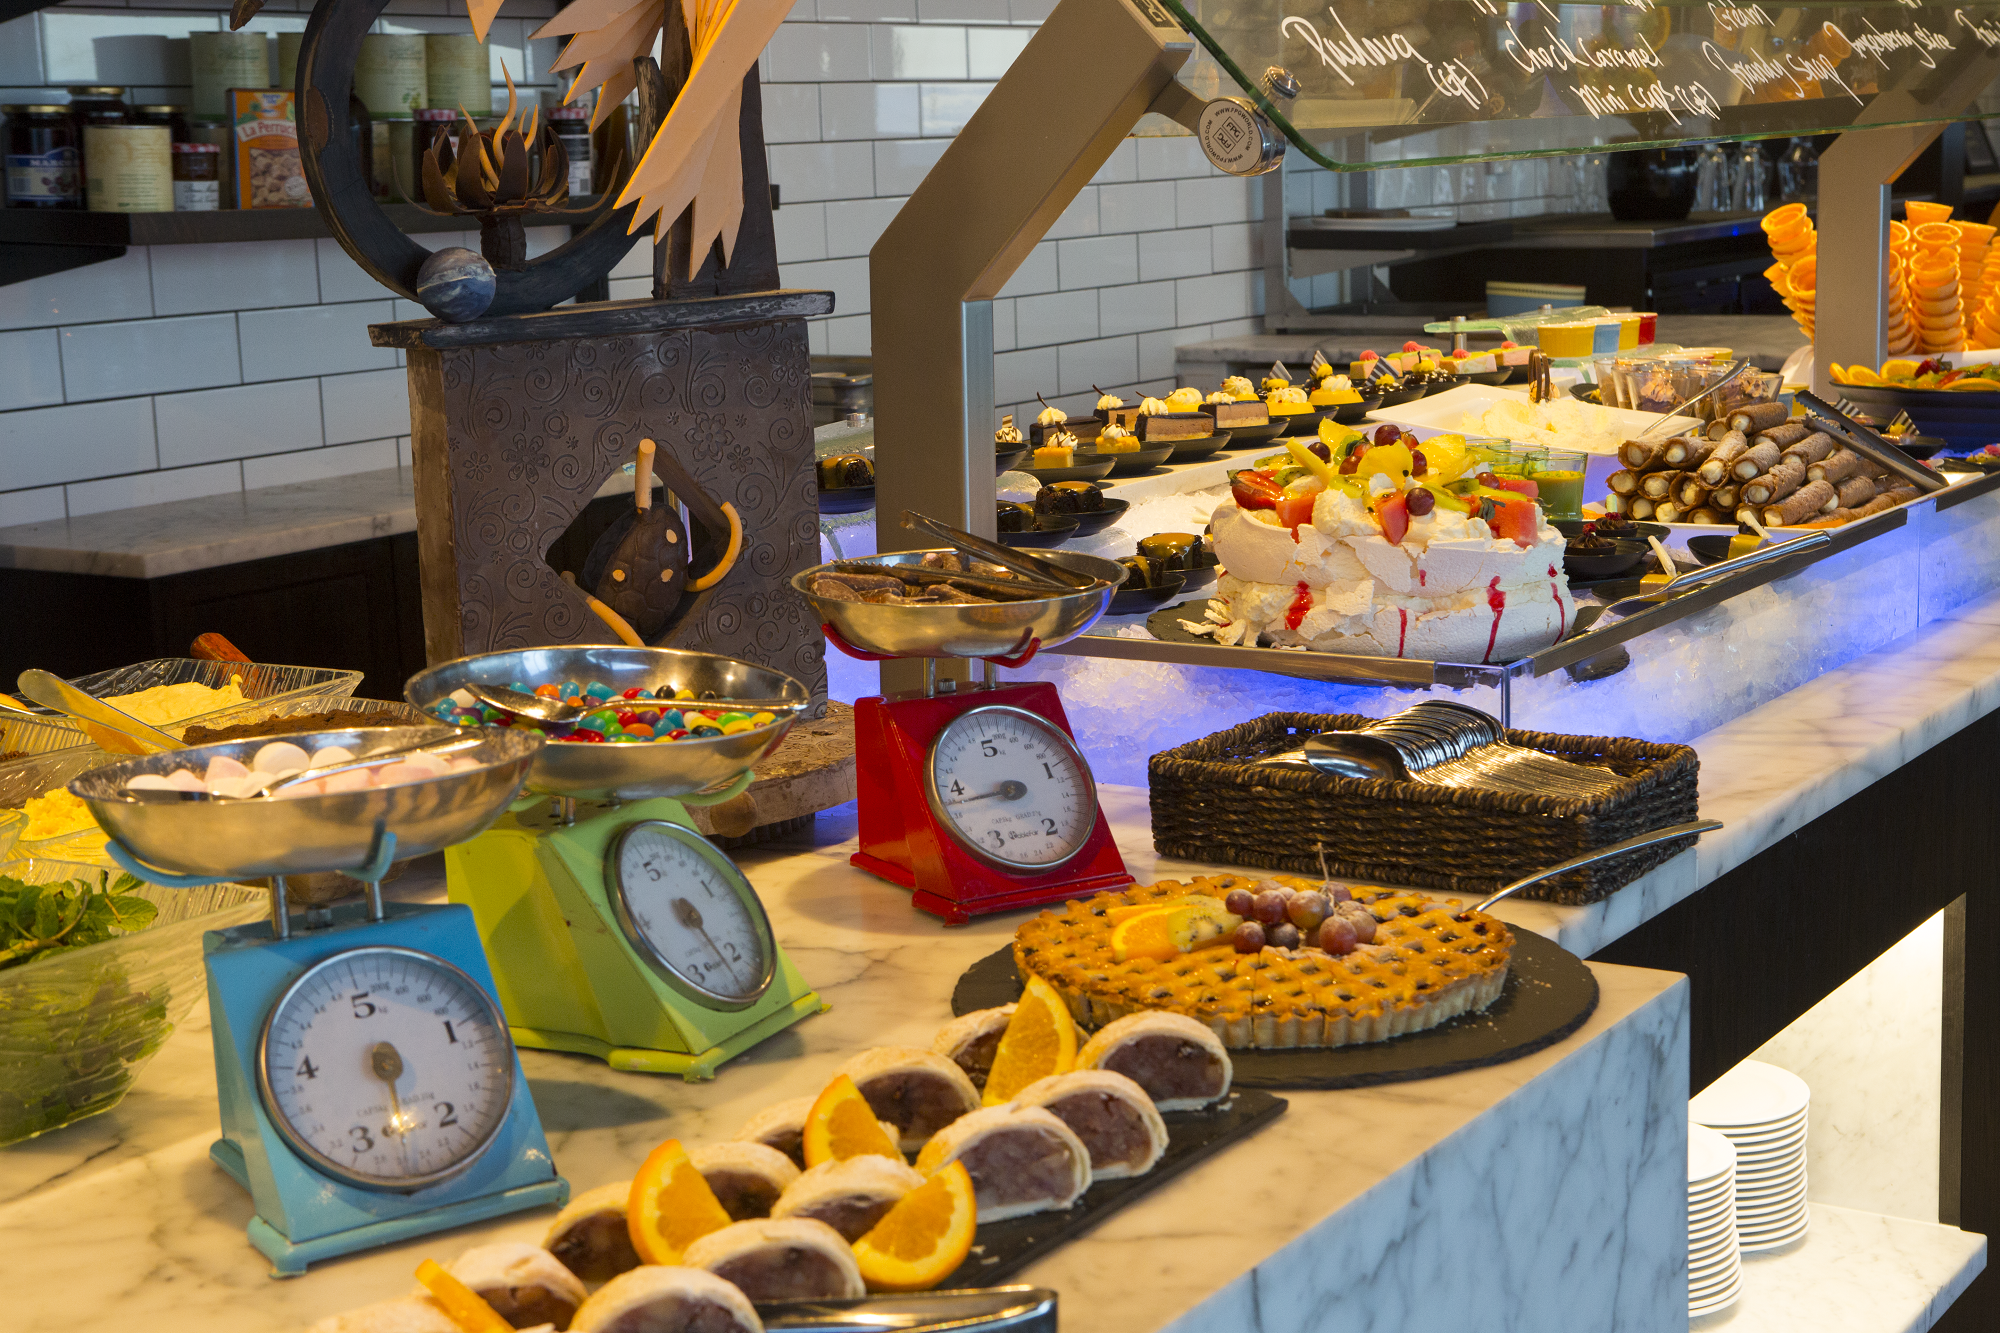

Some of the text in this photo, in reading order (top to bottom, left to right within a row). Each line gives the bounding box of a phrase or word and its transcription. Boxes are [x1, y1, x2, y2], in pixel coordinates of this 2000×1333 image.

[1281, 6, 1429, 86] Pavlova
[241, 125, 257, 138] La
[1214, 107, 1254, 151] WWW.FPGWORLD.COM
[1226, 121, 1241, 138] FPG
[1216, 132, 1232, 149] FPG
[980, 739, 998, 757] 5
[1042, 762, 1054, 780] 1
[950, 779, 965, 796] 4
[1041, 818, 1058, 837] 2
[987, 830, 1005, 848] 3
[643, 861, 661, 881] 5
[700, 880, 714, 898] 1
[724, 943, 742, 962] 2
[687, 964, 705, 983] 3
[352, 992, 376, 1019] 5
[443, 1020, 459, 1044] 1
[296, 1055, 319, 1080] 4
[433, 1101, 458, 1128] 2
[348, 1126, 374, 1153] 3
